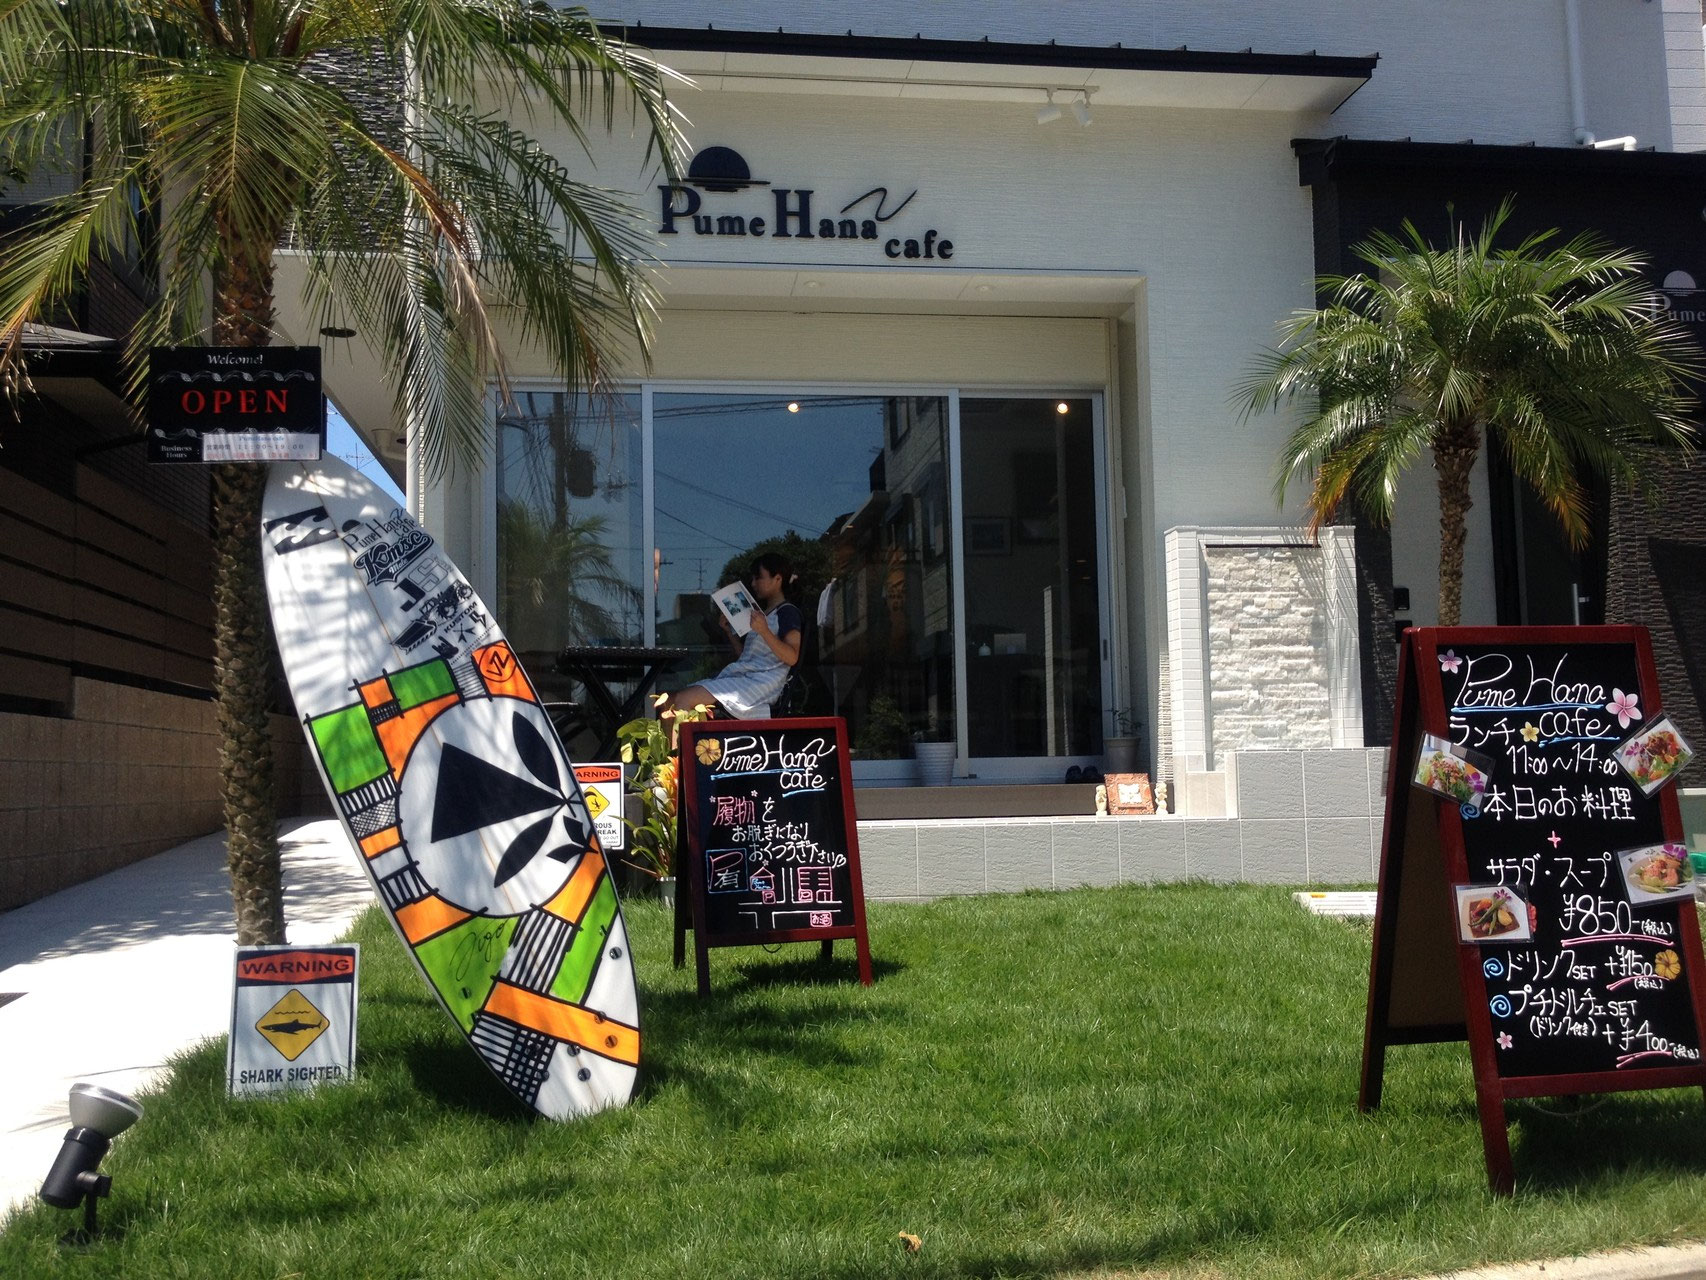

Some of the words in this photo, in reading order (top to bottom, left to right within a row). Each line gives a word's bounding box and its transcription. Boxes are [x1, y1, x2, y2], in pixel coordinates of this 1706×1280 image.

[884, 229, 954, 260] cafe
[207, 352, 263, 365] Welcome!
[181, 389, 288, 414] OPEN
[443, 601, 478, 634] KUSTOM
[1523, 652, 1607, 705] Hana
[1450, 716, 1516, 747] ランチ
[1539, 707, 1612, 738] cafe
[576, 770, 619, 778] ARNING
[779, 769, 827, 789] cafe
[1483, 784, 1636, 821] 本日のお料理
[731, 822, 809, 842] お脱ぎになり
[242, 959, 350, 975] WARNING
[239, 1068, 284, 1084] SHARK
[287, 1065, 342, 1082] SIGHTED
